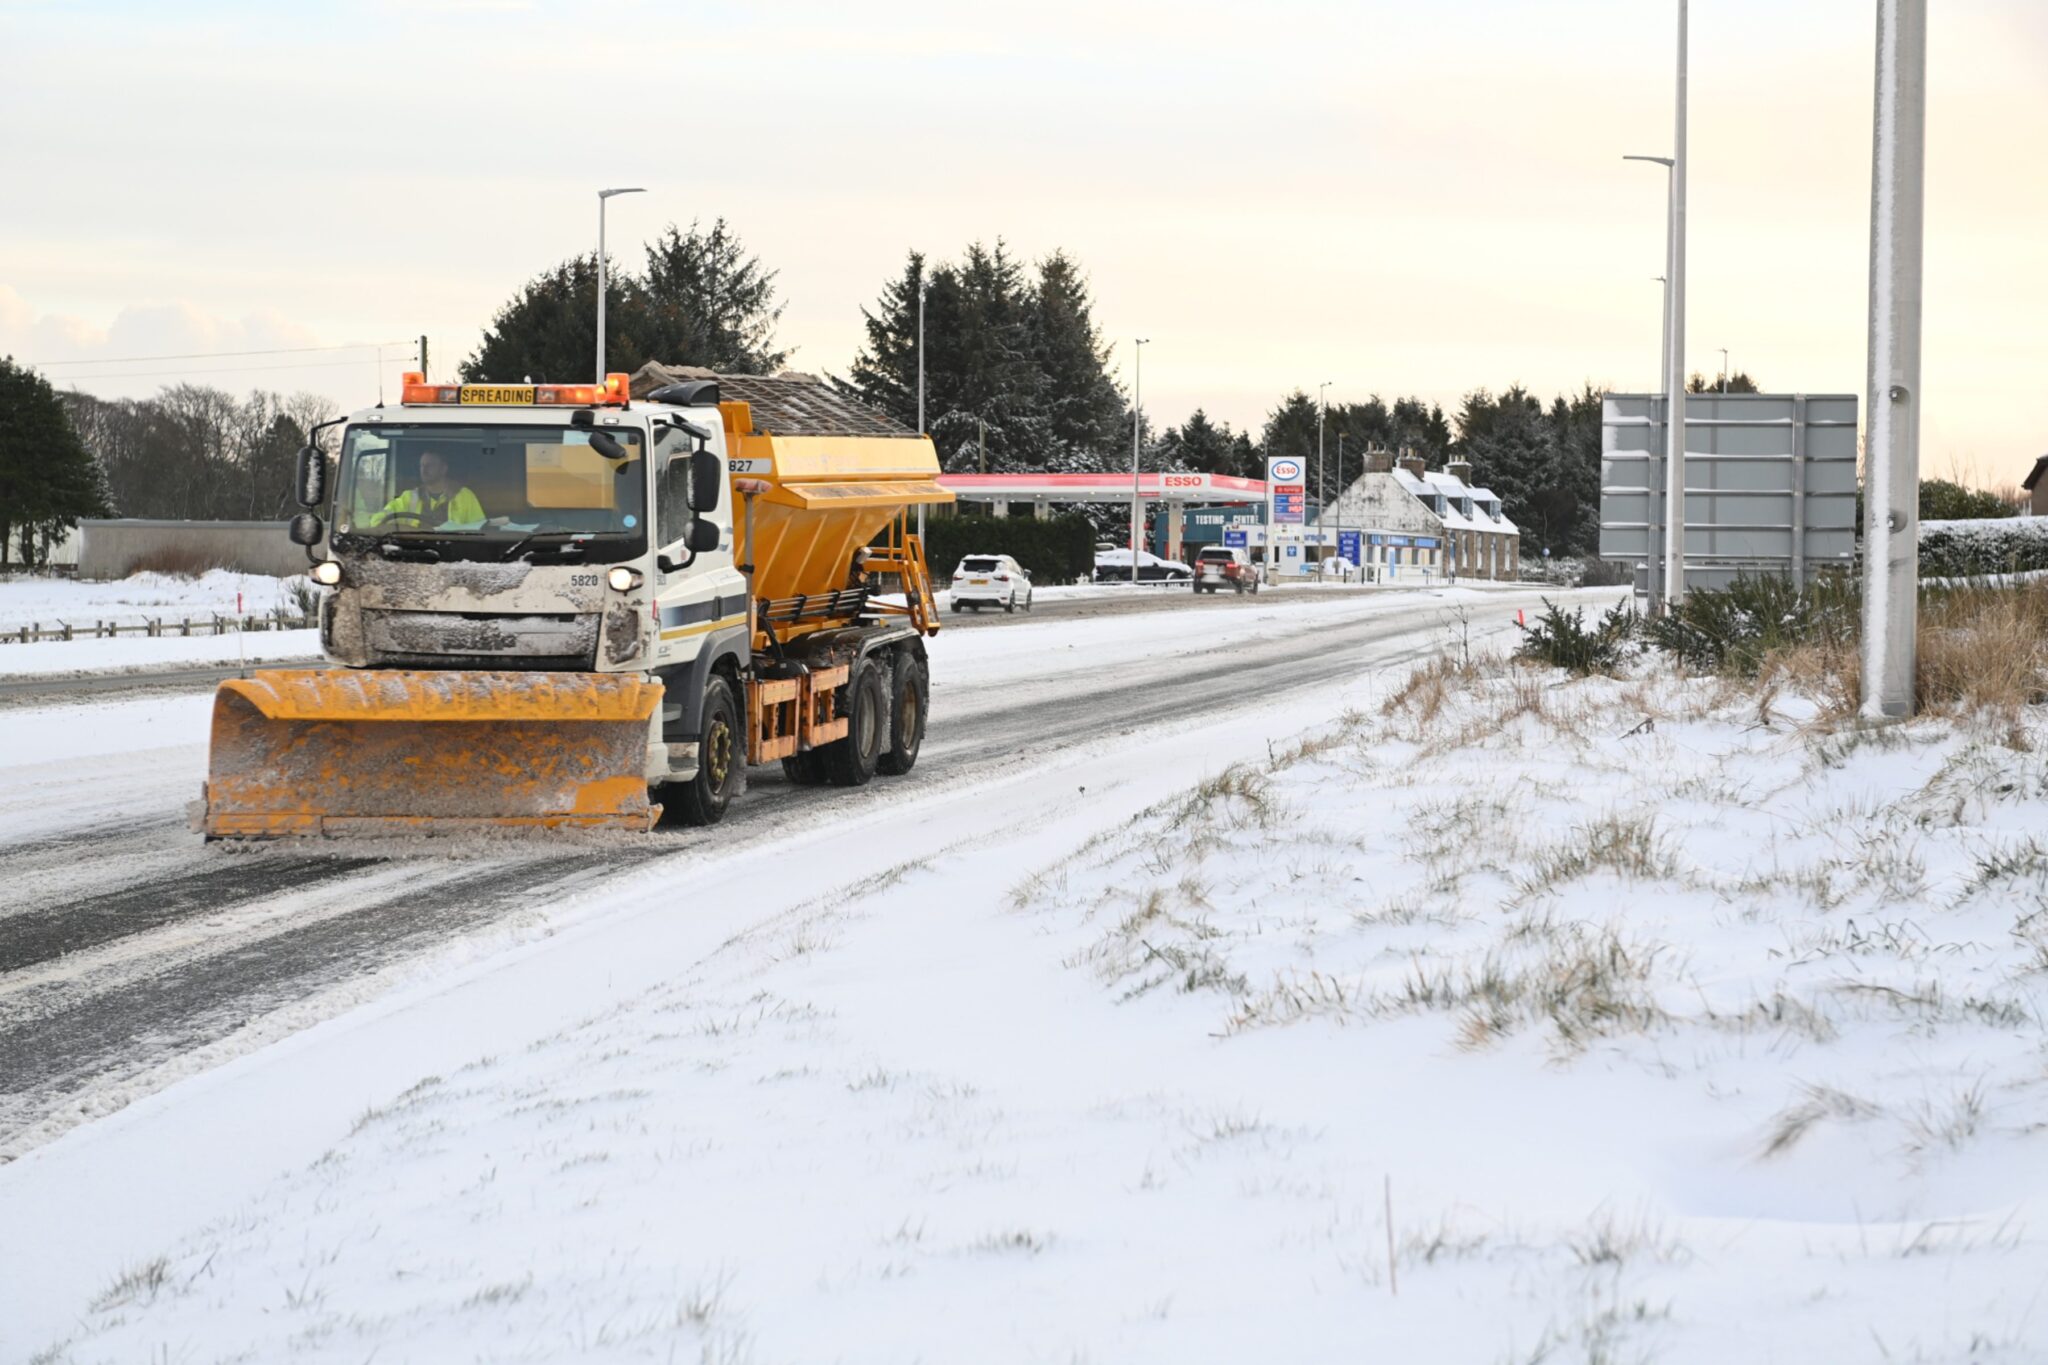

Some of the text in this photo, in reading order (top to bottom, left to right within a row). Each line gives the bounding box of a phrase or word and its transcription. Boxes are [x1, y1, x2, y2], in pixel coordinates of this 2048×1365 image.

[462, 389, 532, 403] SPREADING
[1276, 466, 1296, 475] Esso
[1165, 476, 1202, 486] ESSO
[1195, 515, 1225, 525] TESTING
[1233, 515, 1259, 526] CENTRE
[571, 575, 599, 587] 5820
